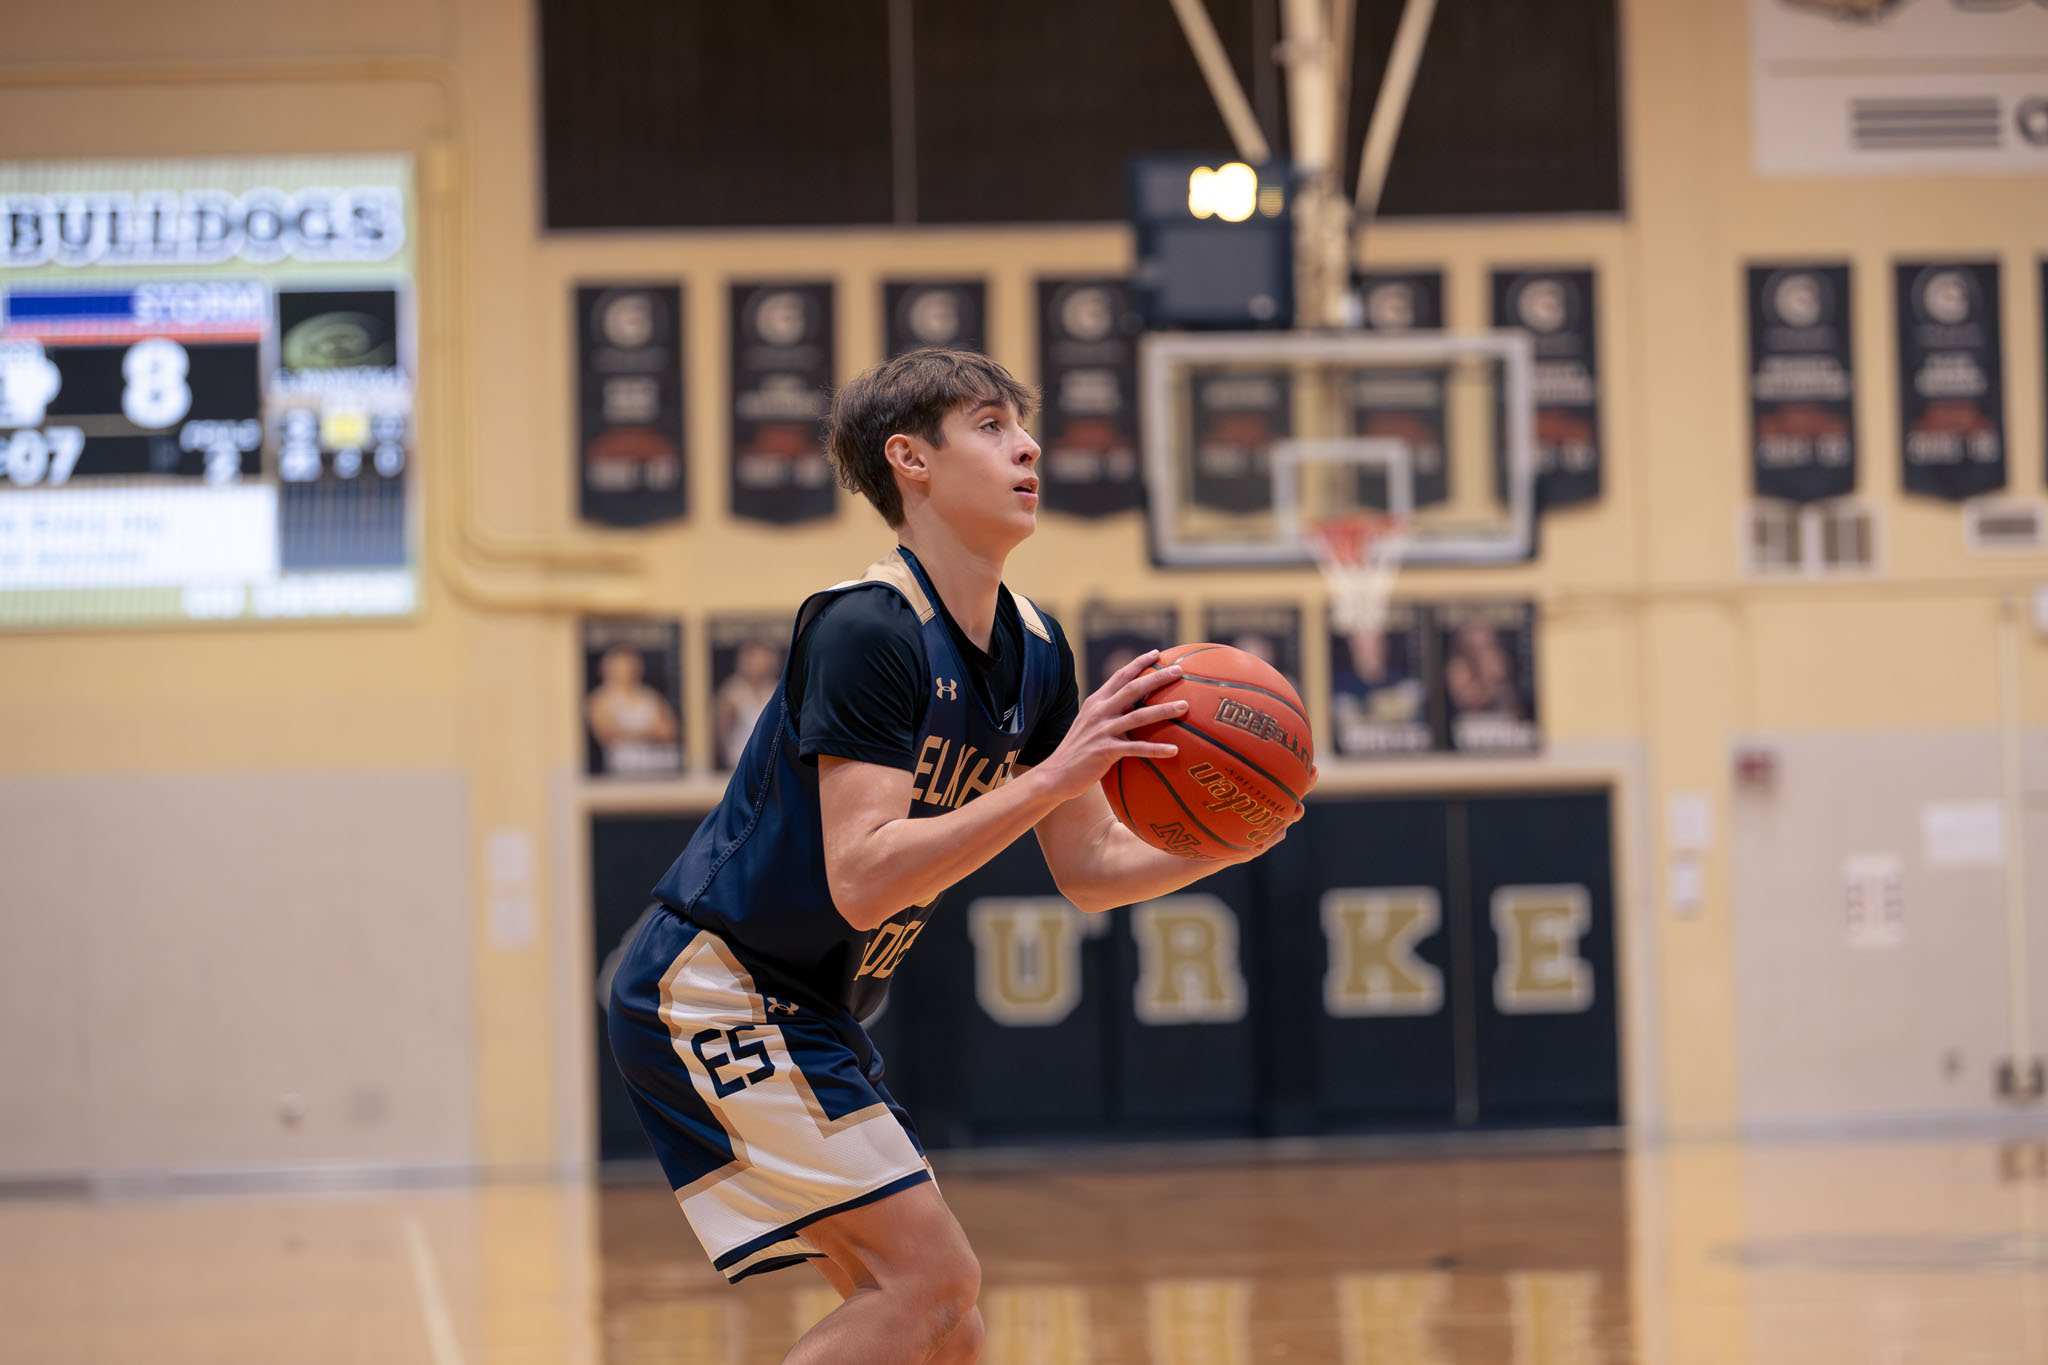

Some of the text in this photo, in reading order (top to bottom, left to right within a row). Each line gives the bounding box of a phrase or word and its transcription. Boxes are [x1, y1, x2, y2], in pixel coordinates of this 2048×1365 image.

[3, 193, 398, 260] BULLDOGS
[122, 337, 192, 428] 8
[1217, 699, 1266, 739] PRO
[1188, 762, 1286, 843] Baden
[691, 1024, 776, 1099] ES
